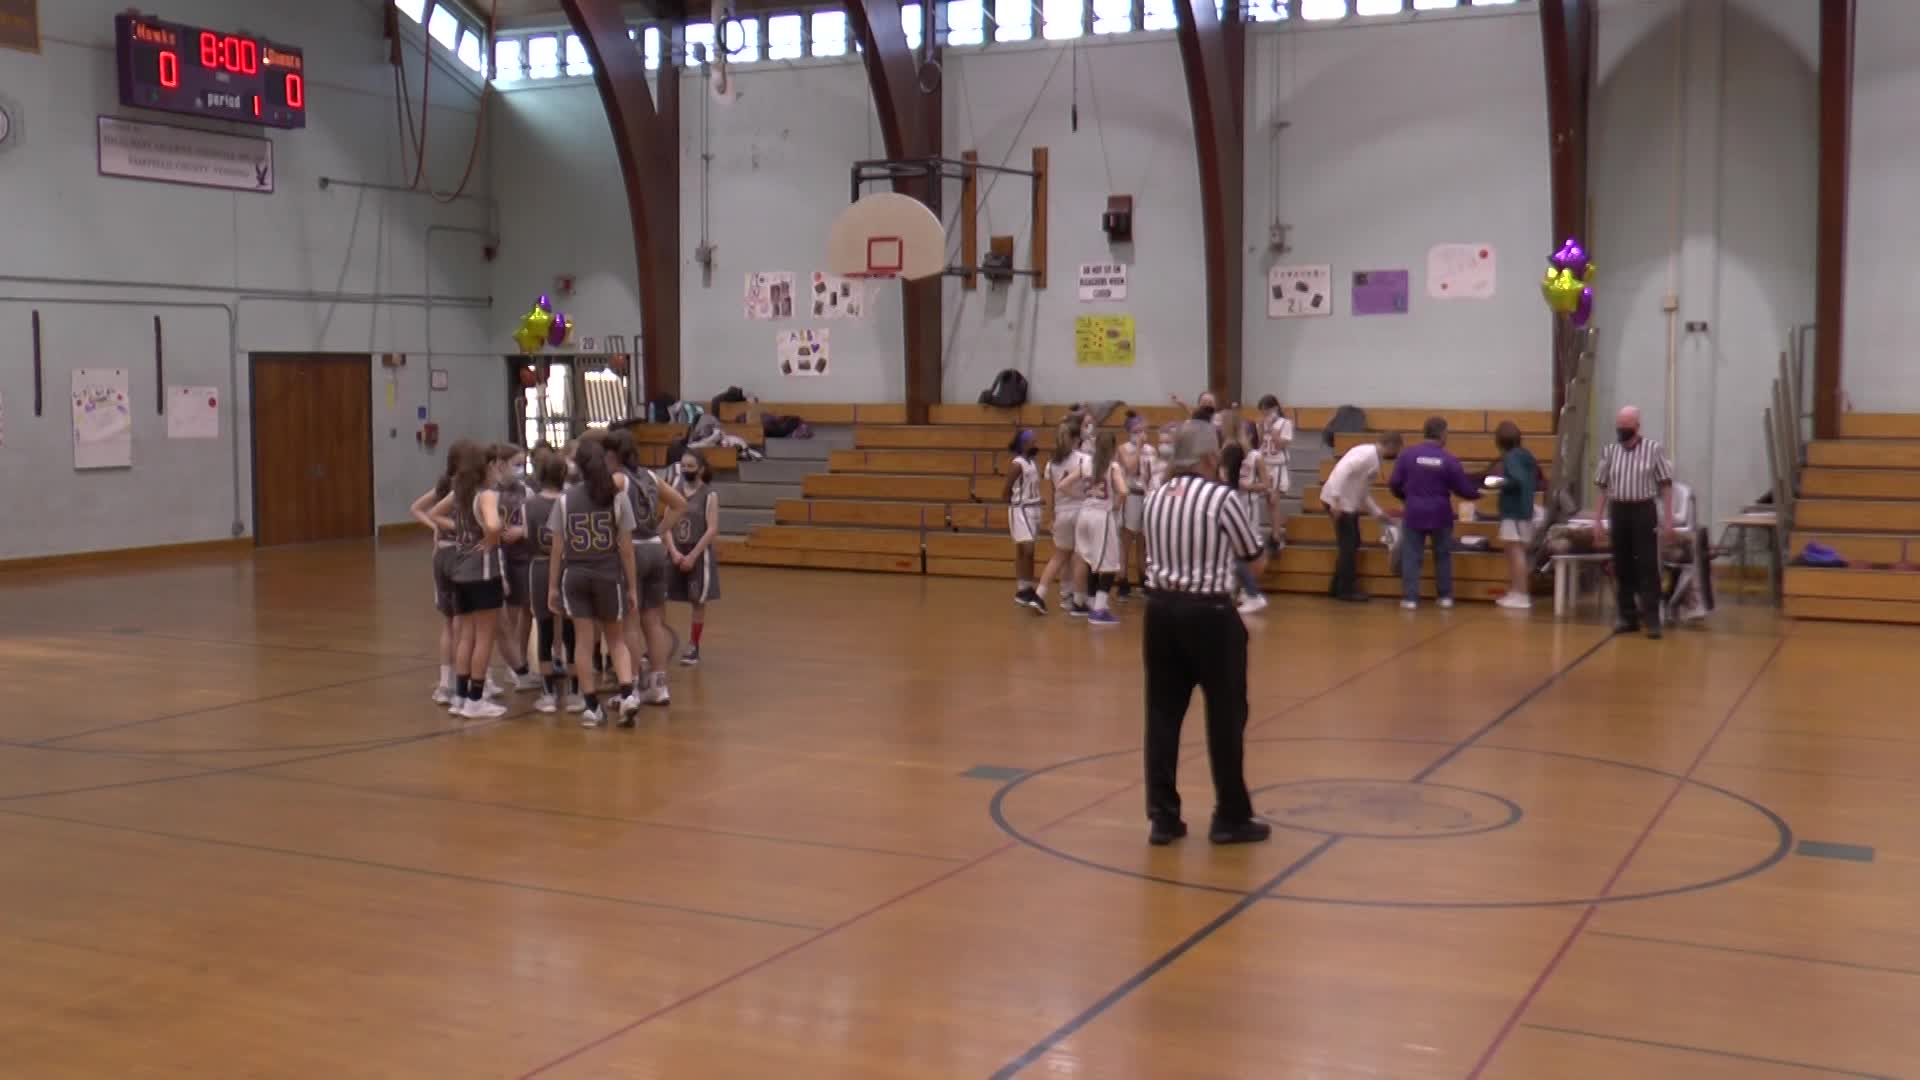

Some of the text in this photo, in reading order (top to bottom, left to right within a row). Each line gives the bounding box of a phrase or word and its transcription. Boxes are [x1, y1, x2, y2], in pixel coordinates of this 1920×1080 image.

[135, 23, 176, 44] Hawks
[159, 52, 177, 87] 0
[200, 32, 257, 74] 8:00
[207, 92, 260, 117] period 1
[286, 73, 303, 108] 0
[568, 512, 613, 553] 55
